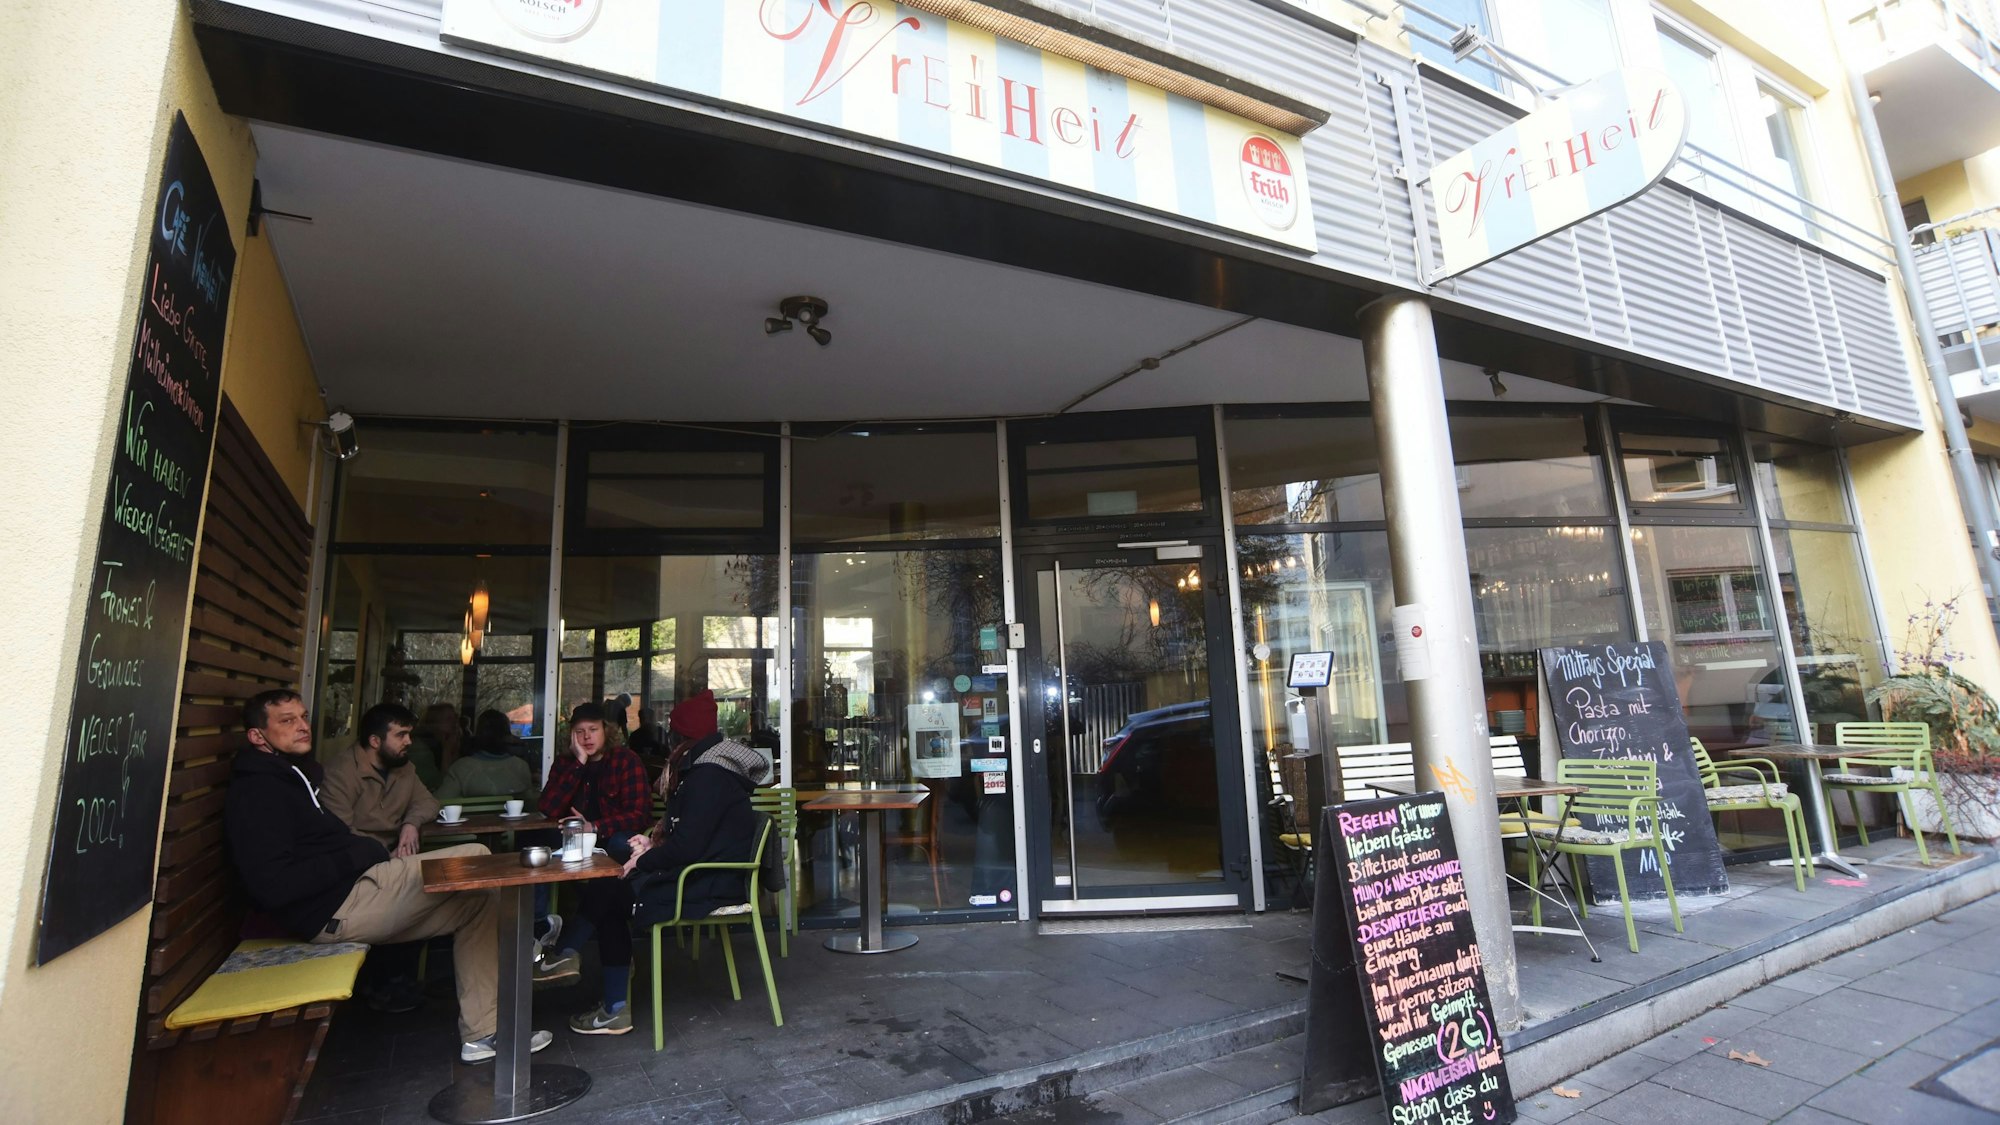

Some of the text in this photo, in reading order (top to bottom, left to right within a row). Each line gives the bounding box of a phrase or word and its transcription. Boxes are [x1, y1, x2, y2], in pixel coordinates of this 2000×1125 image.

[153, 449, 191, 498] HABEN
[100, 561, 143, 628] FROHES
[88, 633, 144, 690] GESUNDES
[1606, 645, 1656, 688] Spezial
[1566, 686, 1653, 719] Pasta mit
[77, 714, 123, 763] NEUES
[984, 780, 1006, 789] 2012
[1337, 808, 1398, 837] REGELN
[1399, 802, 1419, 829] für
[1345, 823, 1436, 860] lieben Gäste:
[1347, 848, 1441, 883] Bitte tragt einen
[1352, 860, 1461, 905] MUND & NASENSCHUTZ
[1356, 874, 1465, 922] bis ihr am Platz sitzt
[1357, 894, 1470, 943] DESINFIZIERT euch
[1363, 921, 1455, 957] eure Hände am
[1365, 947, 1423, 978] Eingang.
[1388, 962, 1456, 996] Innenraum
[1455, 944, 1482, 975] dürft
[1375, 976, 1475, 1023] ihr gerne sitzen
[1379, 1016, 1413, 1040] wenn
[1412, 1008, 1430, 1029] ihr
[1383, 1032, 1437, 1070] Genesen
[1436, 1009, 1492, 1064] (2G)
[1392, 1071, 1499, 1125] Schön dass du
[1399, 1054, 1476, 1104] NACHWEISEN
